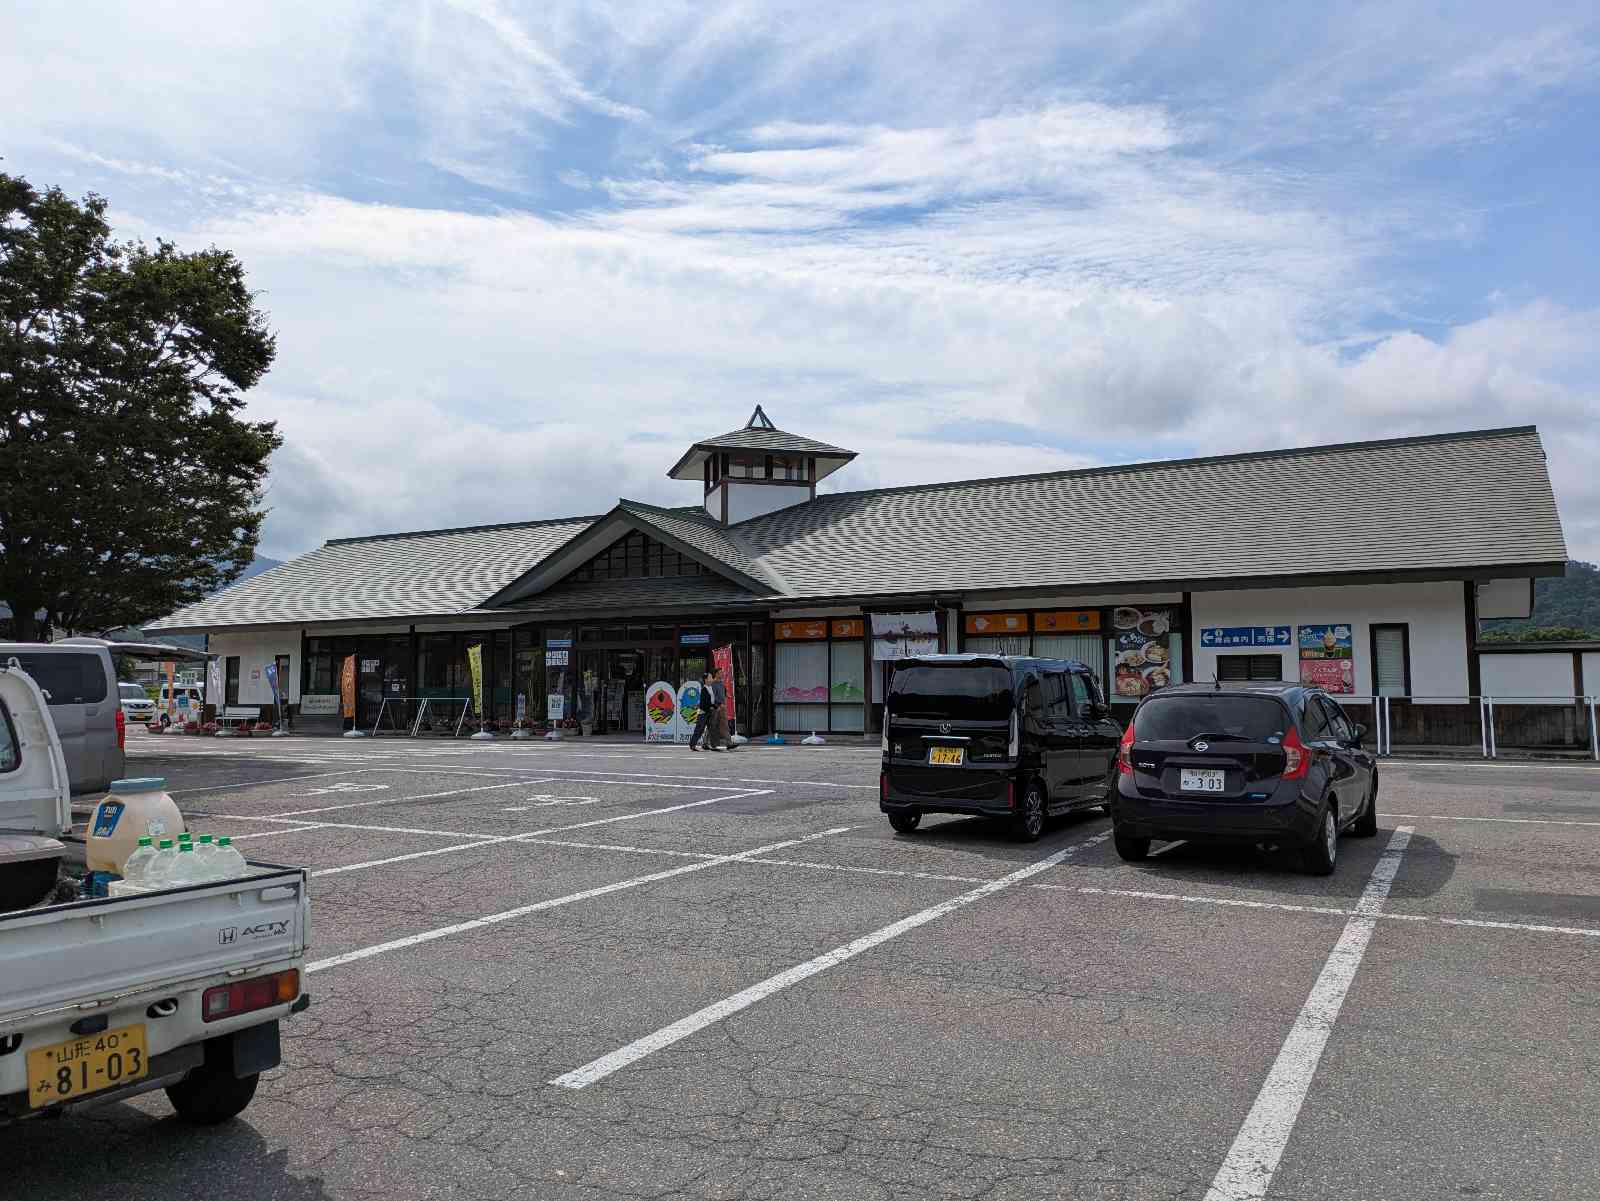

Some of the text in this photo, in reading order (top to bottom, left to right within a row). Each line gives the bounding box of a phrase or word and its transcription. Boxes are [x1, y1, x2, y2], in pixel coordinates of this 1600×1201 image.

[241, 919, 290, 936] ACTY
[57, 1034, 120, 1063] 山形 40
[57, 1047, 141, 1095] 81-03
